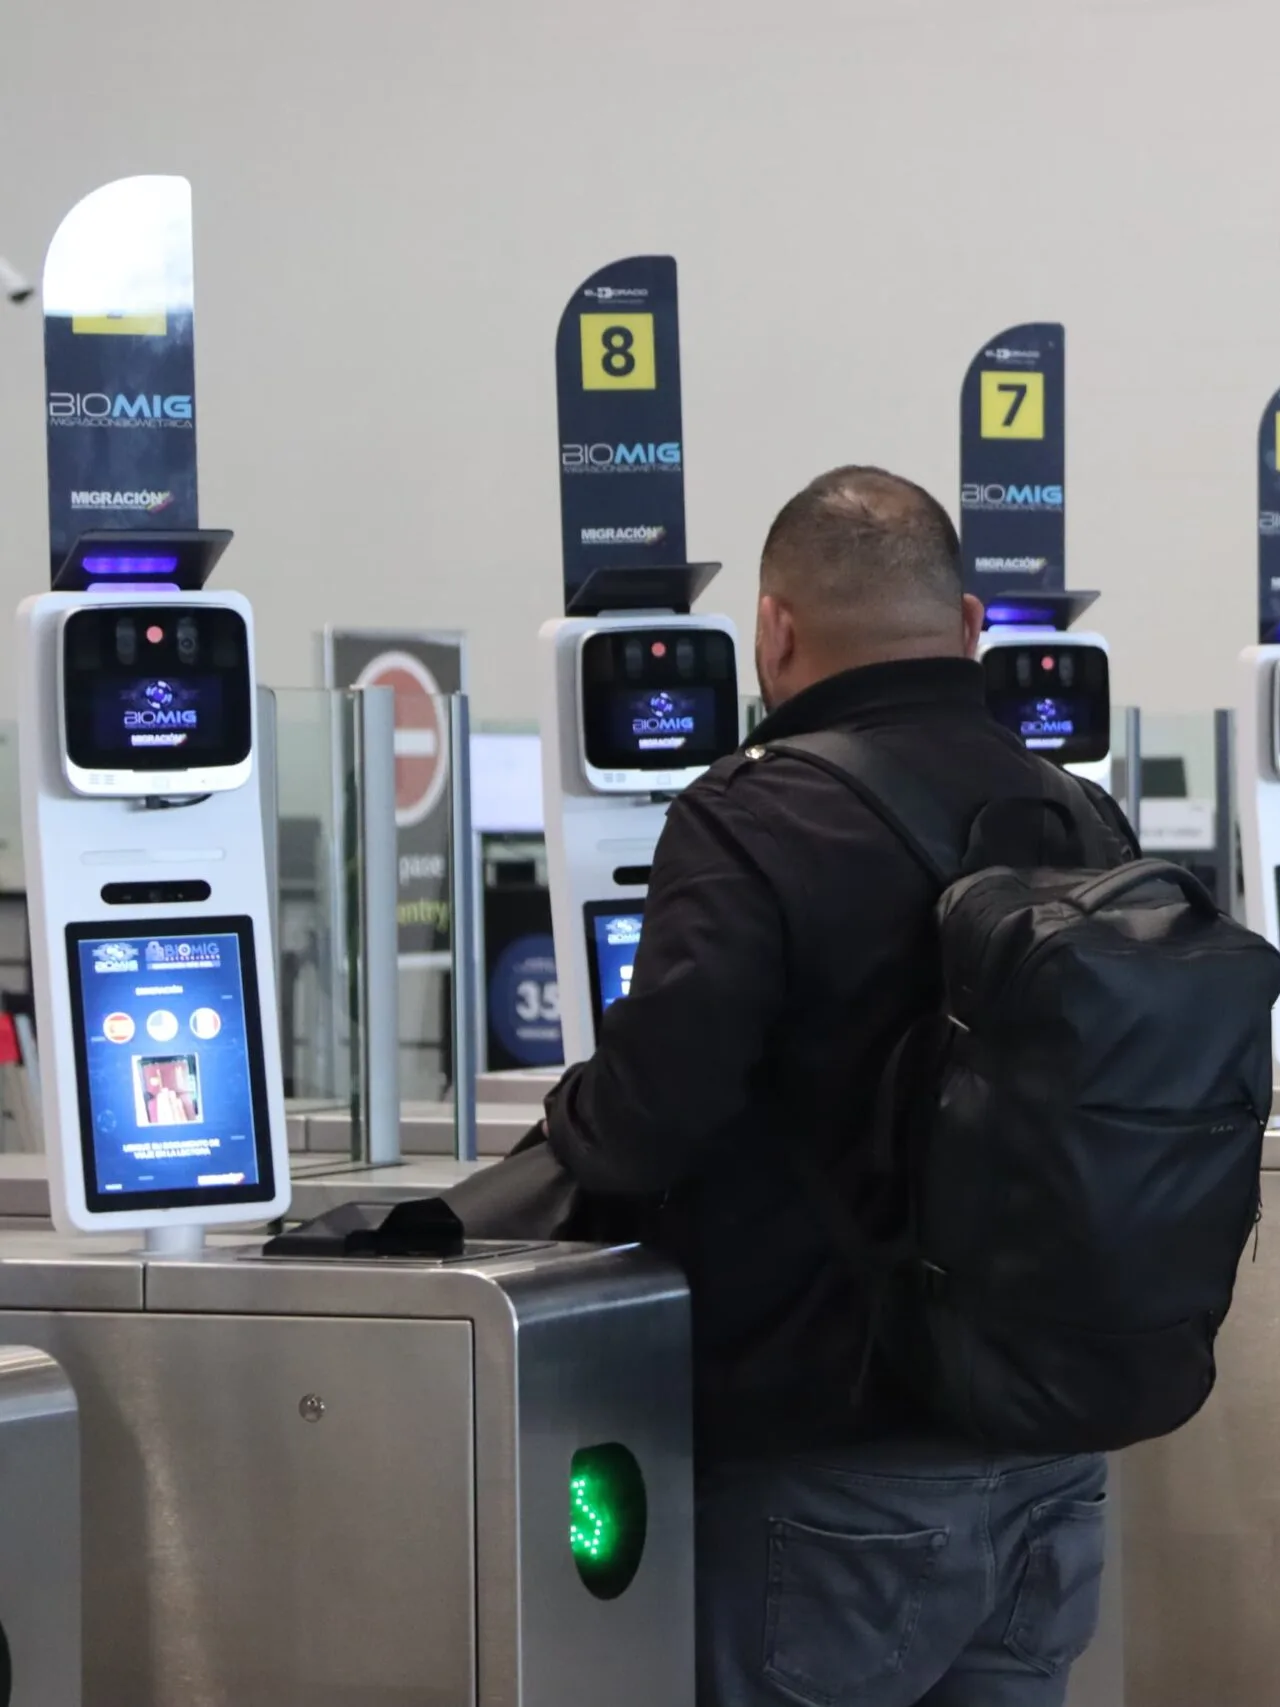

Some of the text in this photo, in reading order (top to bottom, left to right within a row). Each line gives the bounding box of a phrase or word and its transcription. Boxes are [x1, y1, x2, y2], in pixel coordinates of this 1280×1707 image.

[601, 325, 636, 377] 8
[48, 392, 193, 419] BIOMIG
[997, 383, 1028, 427] 7
[562, 442, 681, 465] BIOMIG
[71, 489, 163, 505] MIGRACIÓN
[961, 483, 1063, 504] BIOMIG
[581, 525, 658, 540] MIGRACIÓN
[124, 709, 197, 724] BIOMIG
